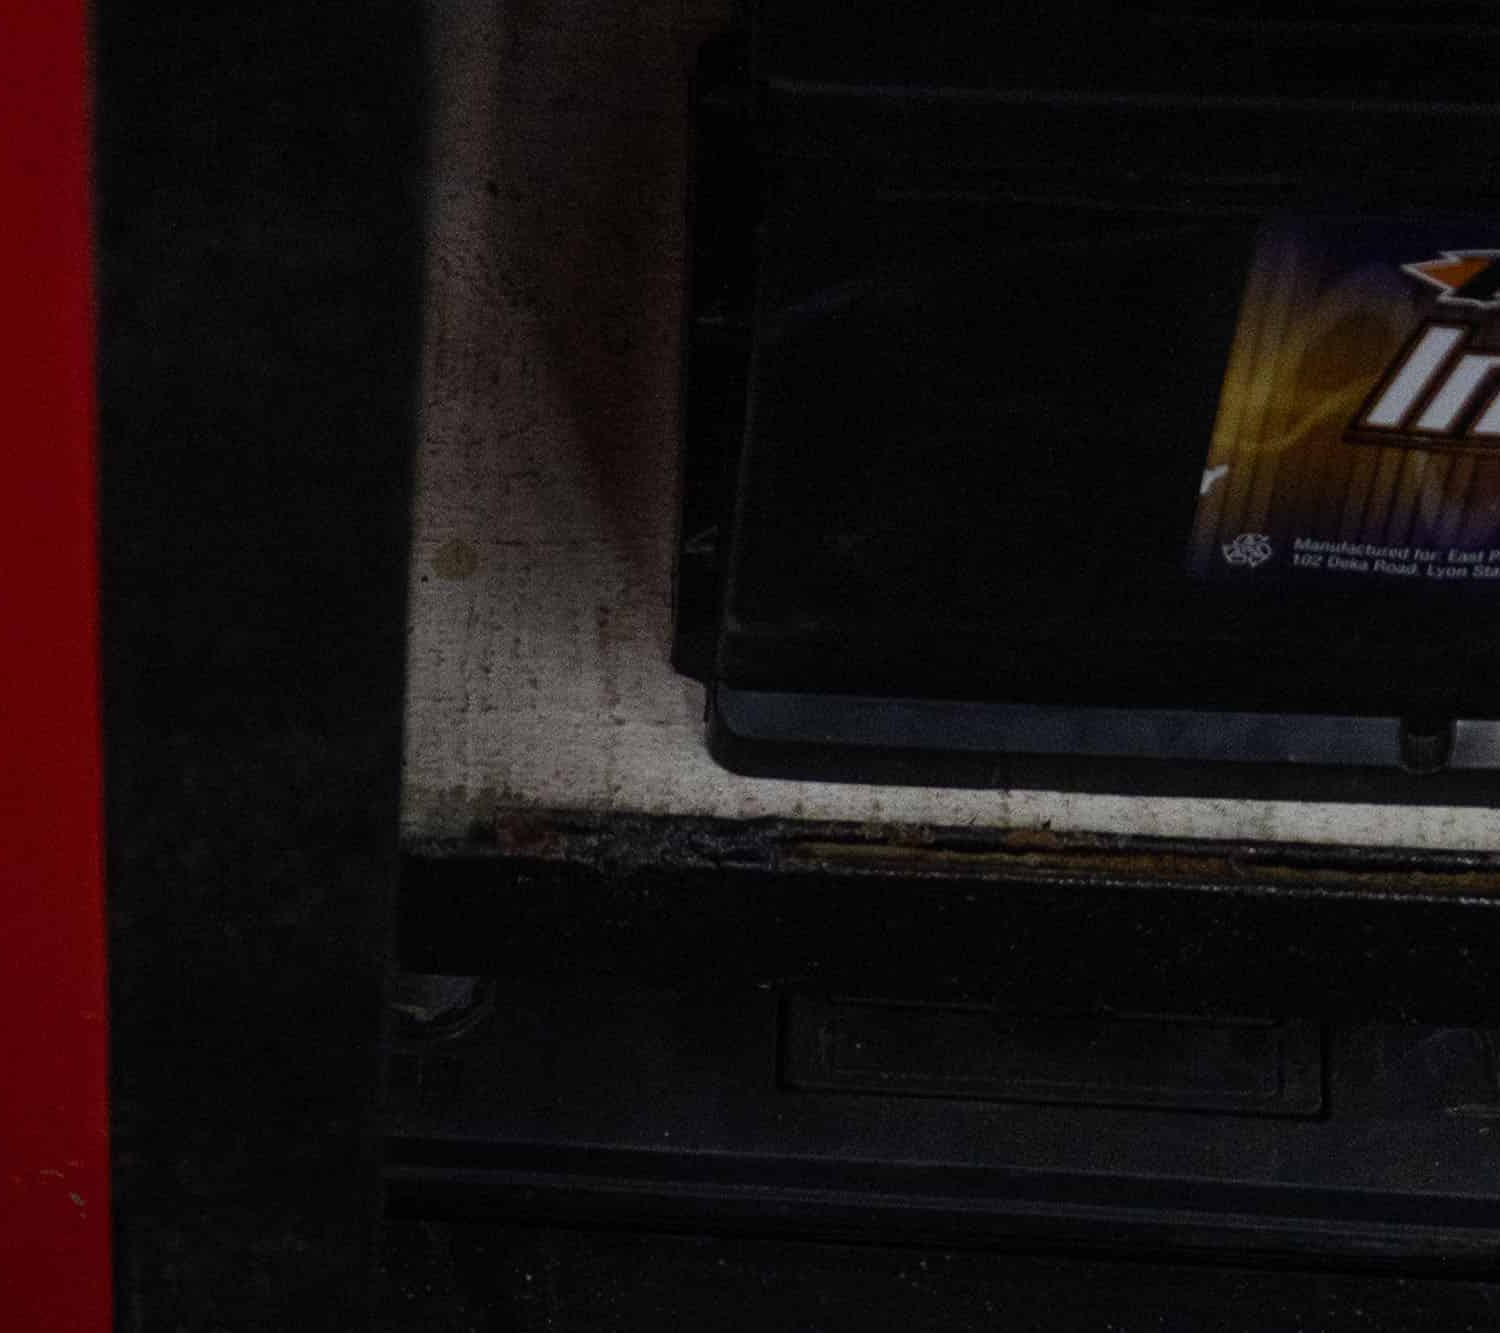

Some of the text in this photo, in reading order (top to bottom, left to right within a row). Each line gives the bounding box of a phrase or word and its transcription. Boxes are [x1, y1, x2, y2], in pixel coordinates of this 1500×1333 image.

[1293, 538, 1410, 560] Manufactured
[1447, 548, 1485, 563] East
[1327, 556, 1369, 573] Deka
[1426, 564, 1467, 579] Lyon
